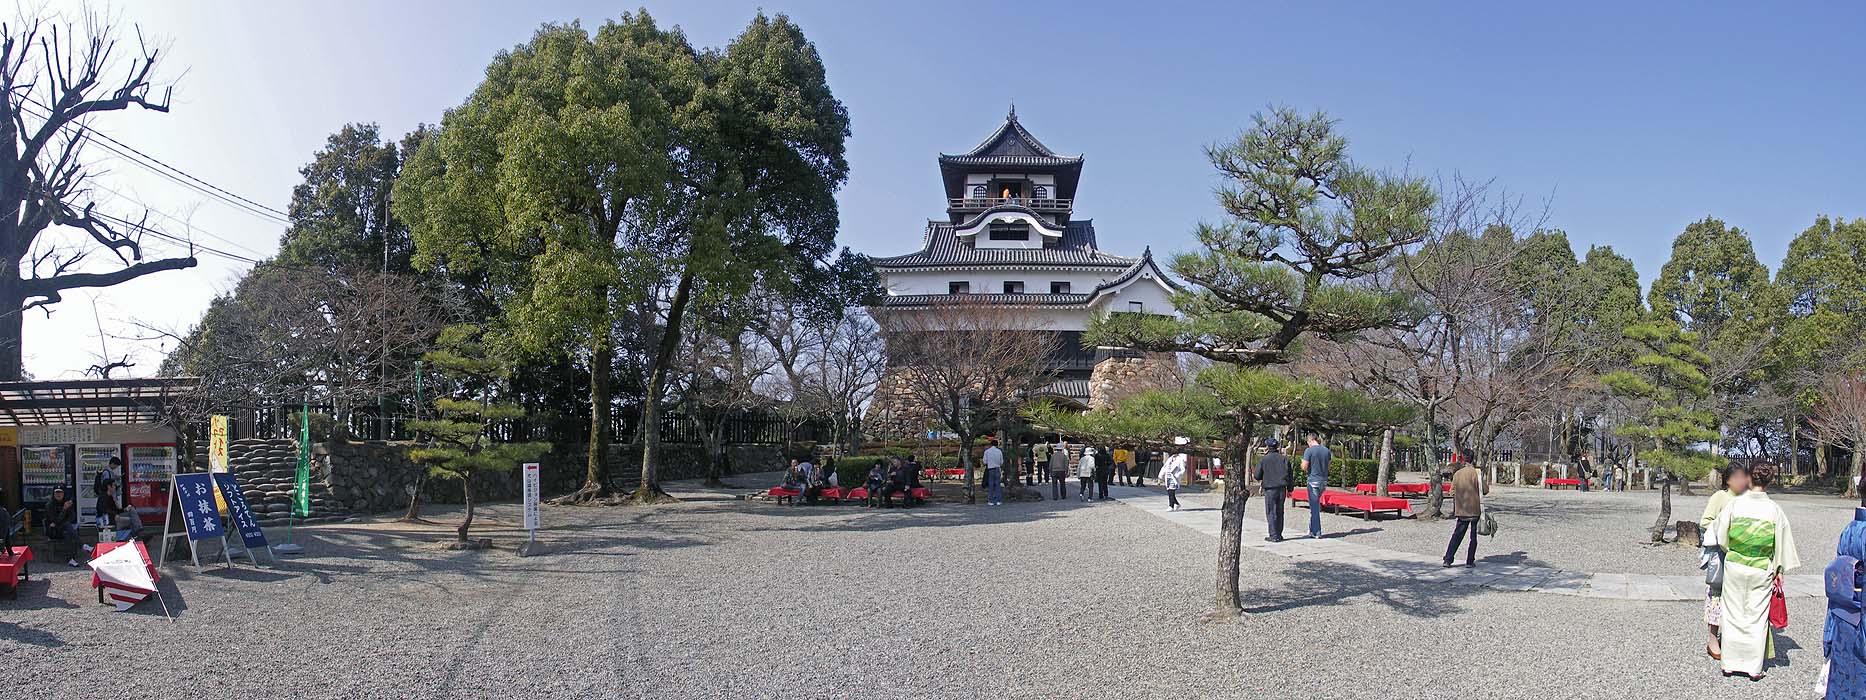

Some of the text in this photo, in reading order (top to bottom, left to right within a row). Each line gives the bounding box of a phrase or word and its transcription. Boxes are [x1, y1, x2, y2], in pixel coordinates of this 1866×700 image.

[195, 482, 216, 532] お抹茶
[223, 484, 249, 529] ソフトアイス
[232, 484, 256, 528] ところてん
